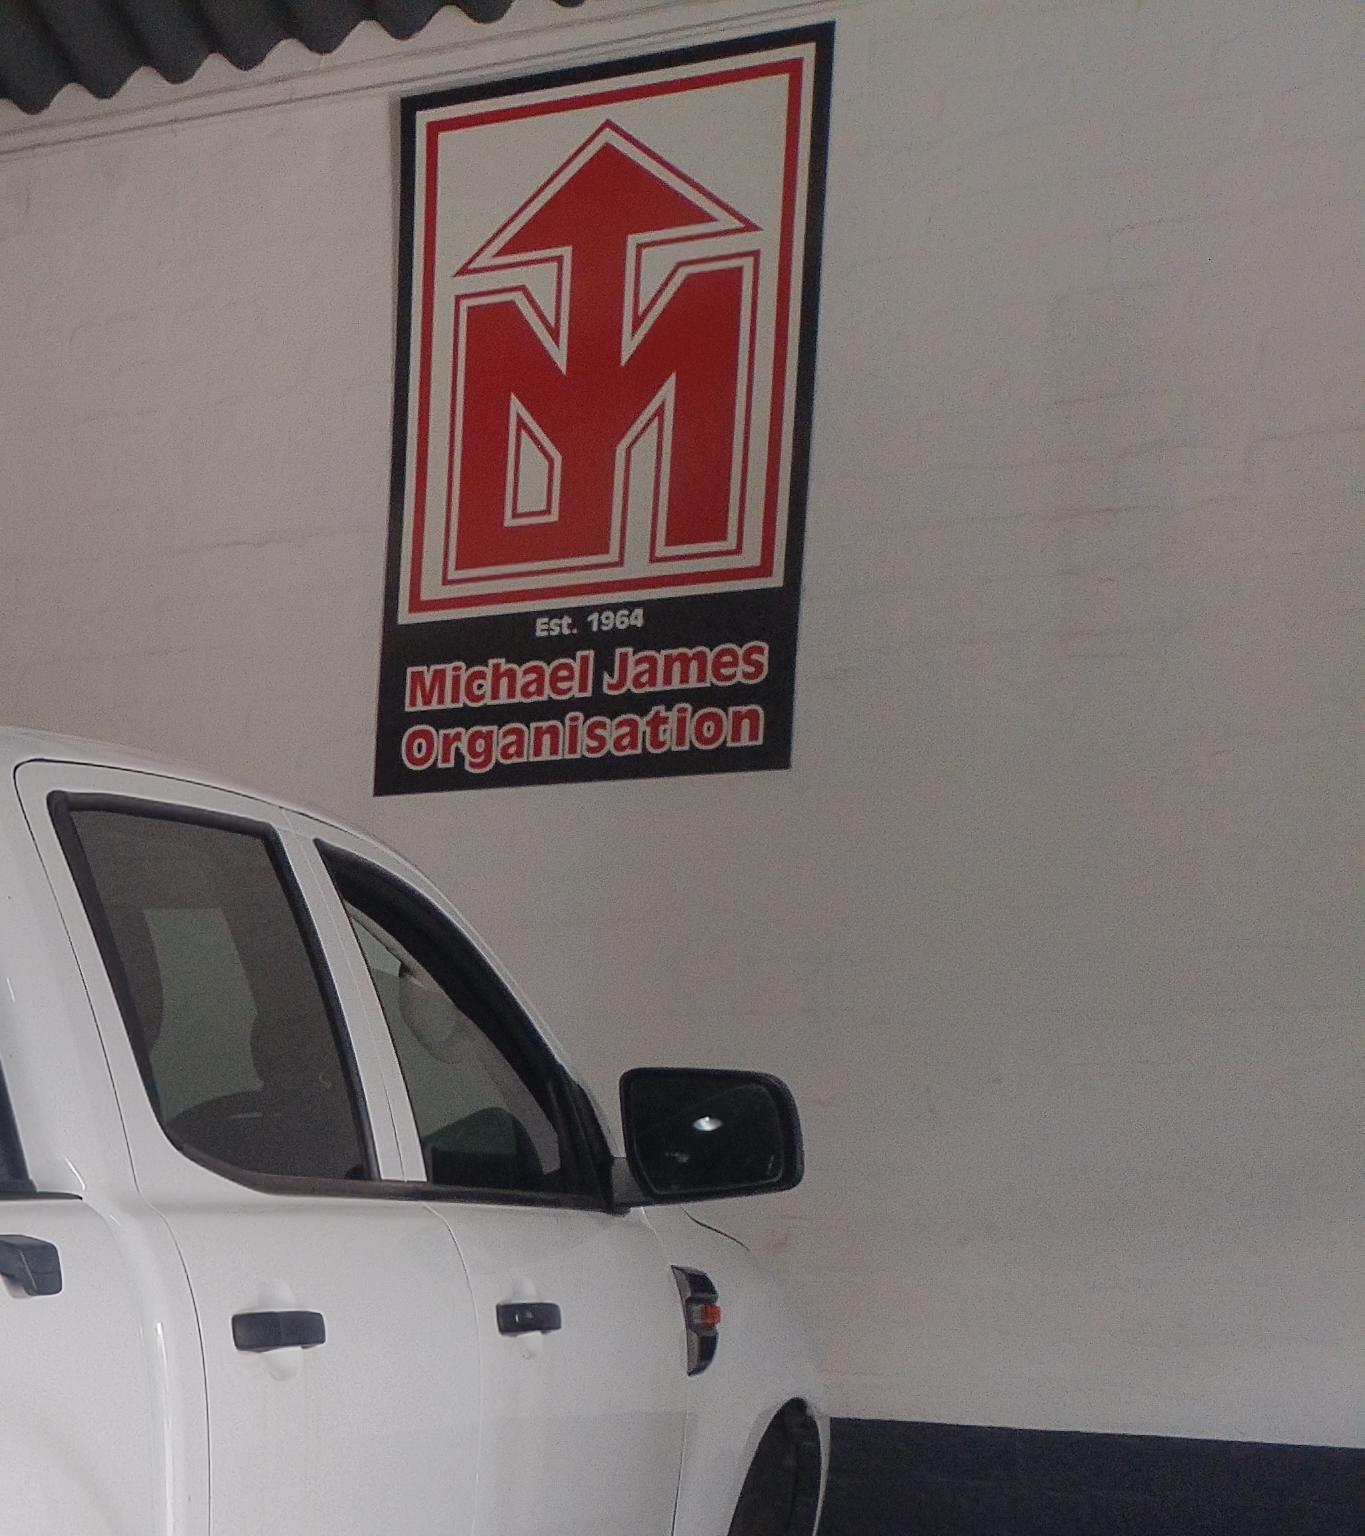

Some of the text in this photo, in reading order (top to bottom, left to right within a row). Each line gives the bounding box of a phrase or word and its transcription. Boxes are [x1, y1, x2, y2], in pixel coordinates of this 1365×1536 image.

[535, 608, 645, 638] Est. 1964
[405, 641, 769, 712] Michael James
[402, 703, 764, 773] Organisation
